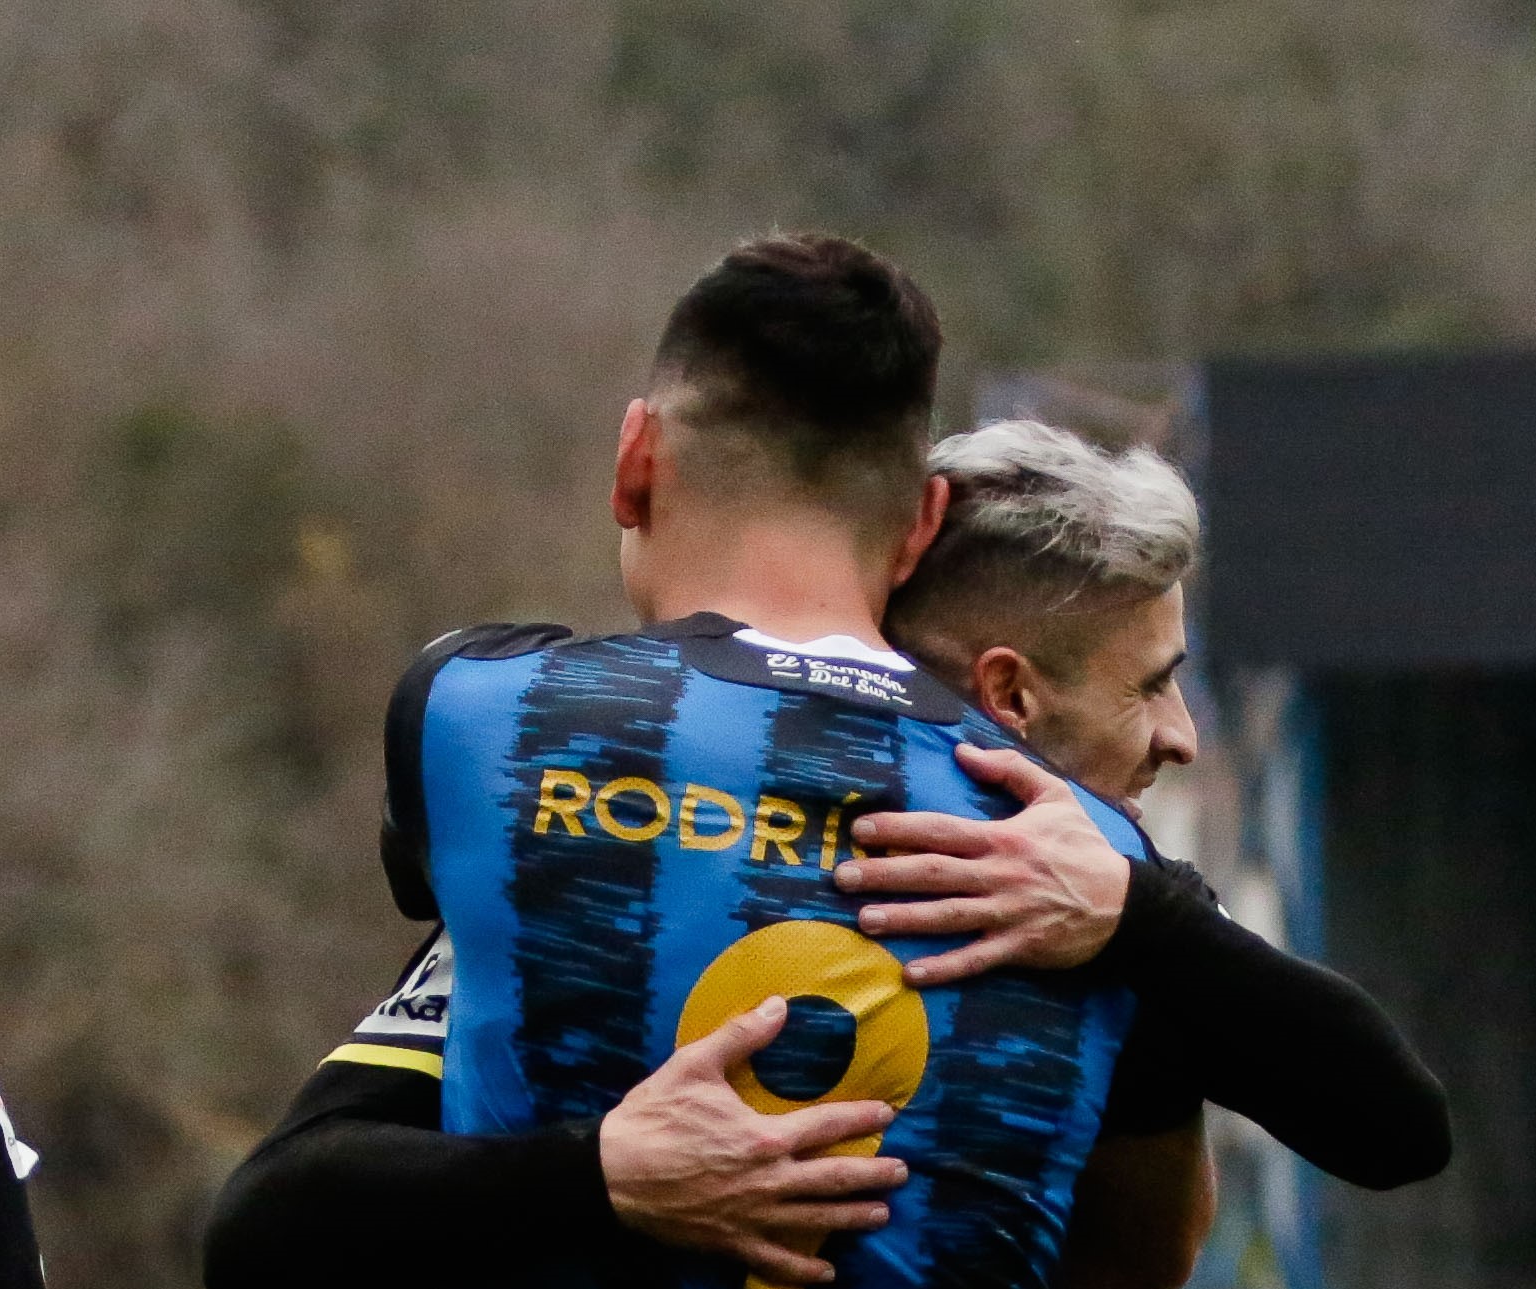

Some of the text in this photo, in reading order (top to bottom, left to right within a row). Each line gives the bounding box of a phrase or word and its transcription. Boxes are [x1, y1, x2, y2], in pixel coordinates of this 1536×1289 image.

[766, 653, 801, 668] El
[808, 669, 891, 701] Del Sur
[533, 768, 888, 872] RODRÍ
